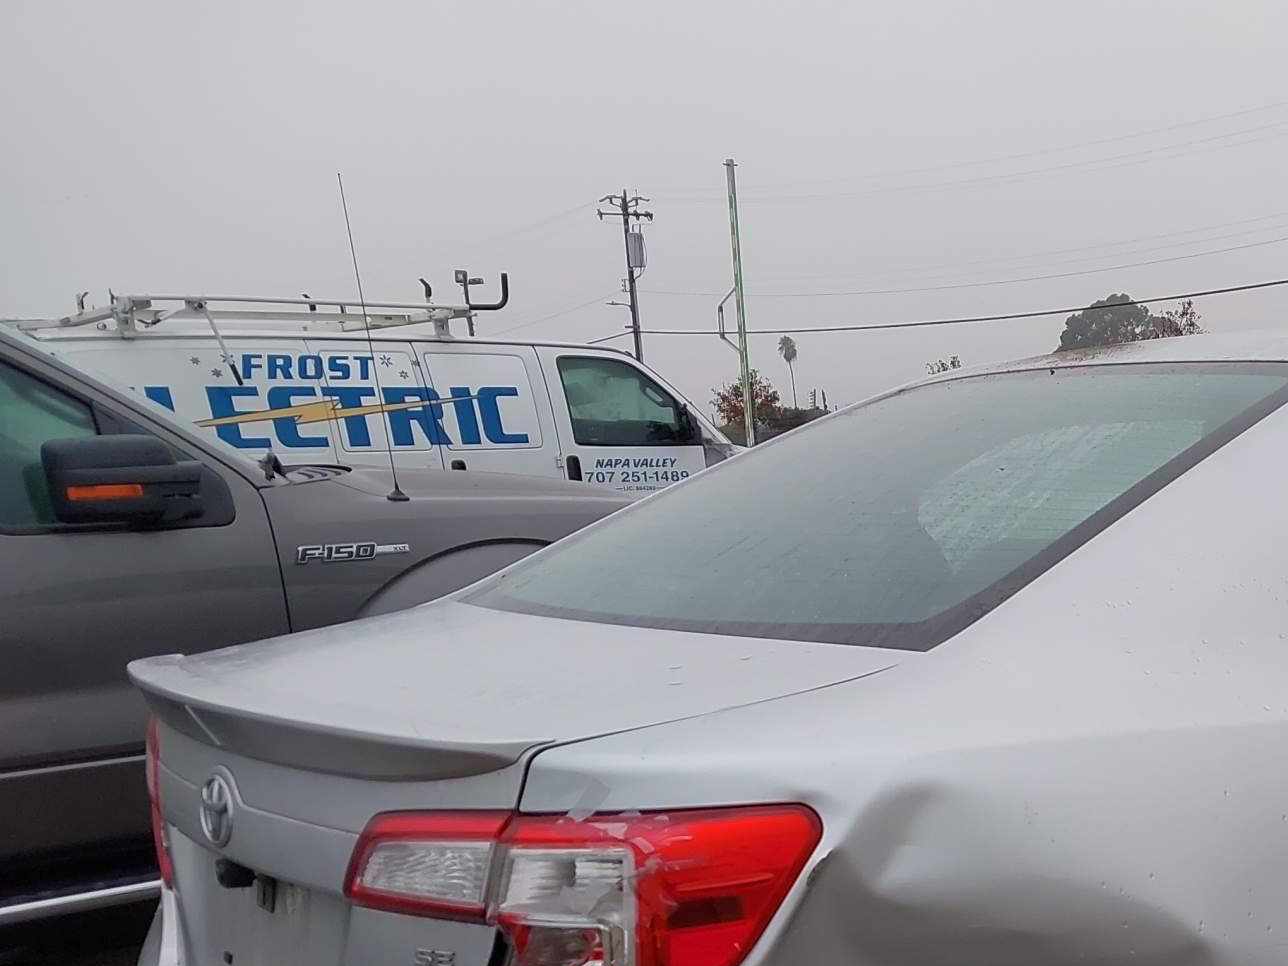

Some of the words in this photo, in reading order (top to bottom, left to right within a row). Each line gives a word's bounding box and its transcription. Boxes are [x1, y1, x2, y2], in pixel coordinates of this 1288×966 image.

[241, 354, 374, 380] FROST
[142, 386, 530, 449] ECTRIC
[595, 458, 630, 469] NAPA
[633, 458, 677, 469] VALLEY
[584, 471, 616, 483] 707
[621, 470, 690, 483] 251-1489
[297, 542, 377, 563] F-150
